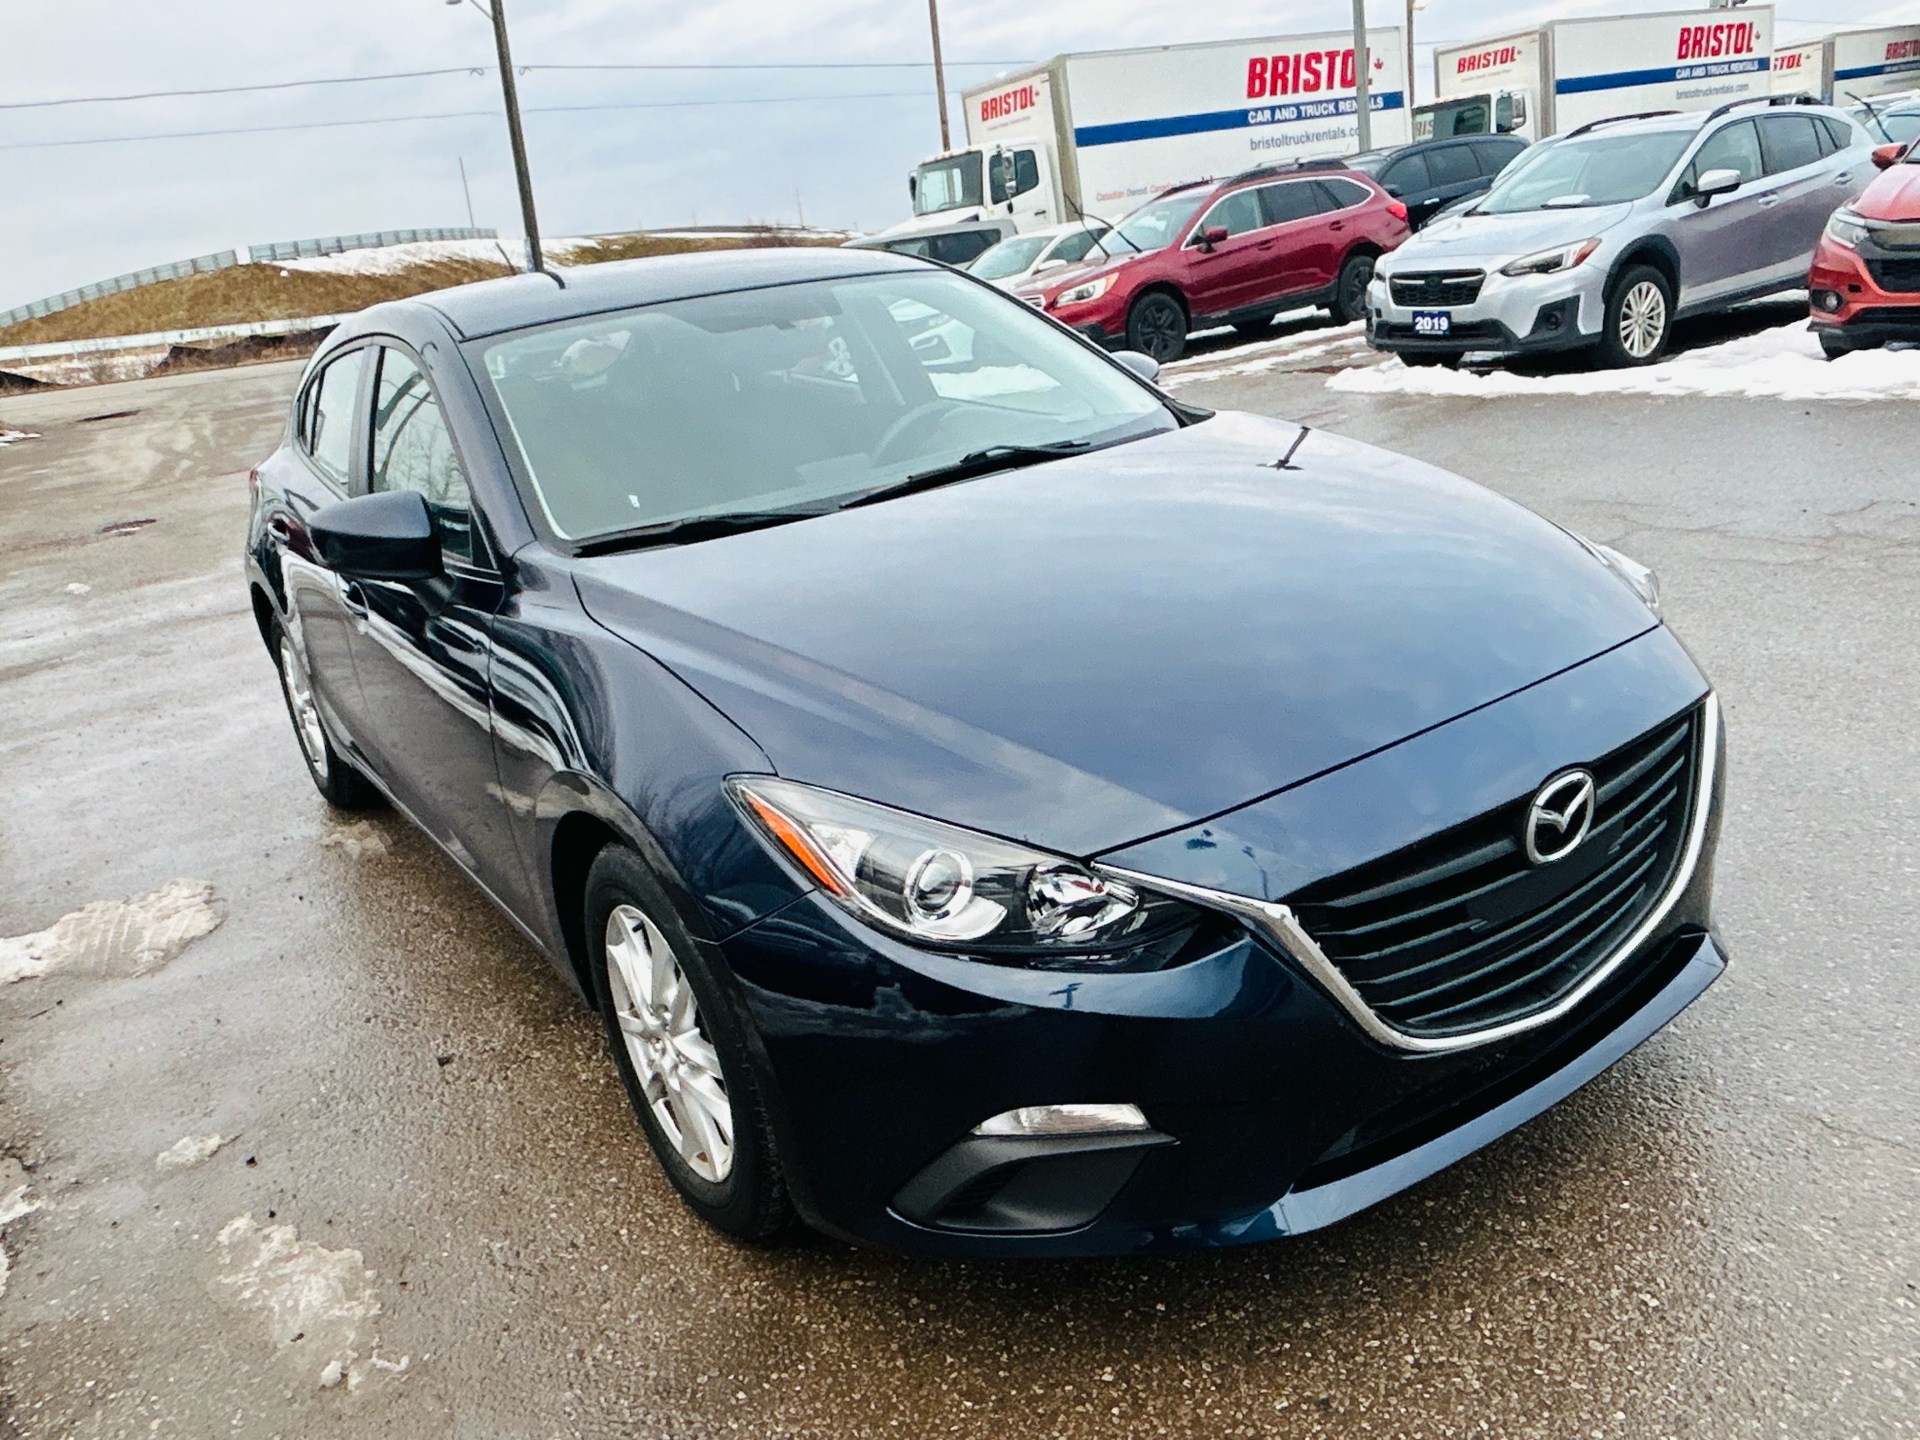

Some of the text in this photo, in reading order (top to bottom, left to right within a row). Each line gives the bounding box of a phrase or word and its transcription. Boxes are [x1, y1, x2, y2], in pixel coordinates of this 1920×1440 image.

[1677, 22, 1753, 59] BRISTOL
[1885, 39, 1920, 60] BRISTO
[1456, 46, 1516, 74] BRISTOL
[980, 85, 1035, 122] BRISTOL
[1247, 97, 1384, 124] CAR AND TRUCK RENLS
[1250, 126, 1360, 151] bristoltruckrentals.co
[1414, 315, 1449, 331] 2019
